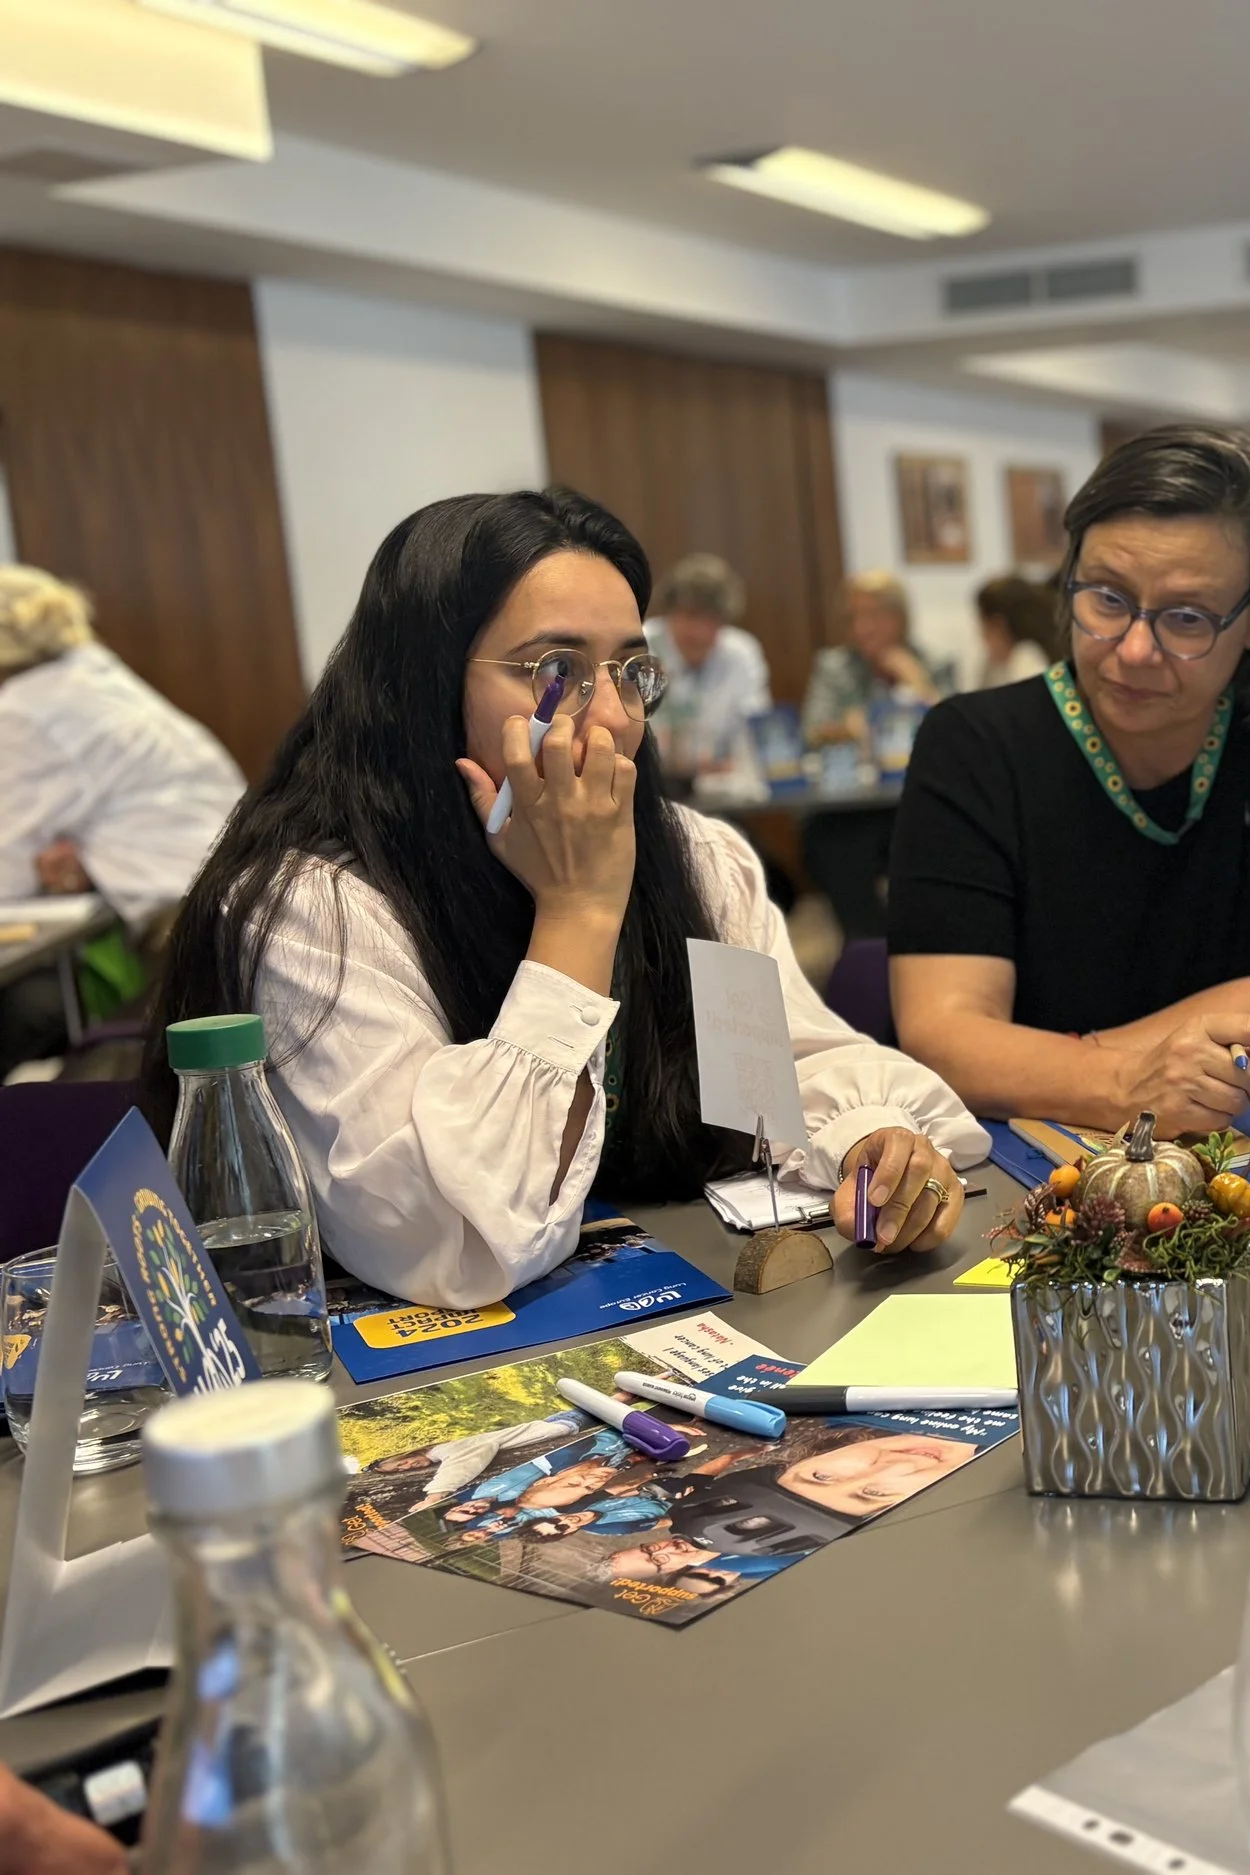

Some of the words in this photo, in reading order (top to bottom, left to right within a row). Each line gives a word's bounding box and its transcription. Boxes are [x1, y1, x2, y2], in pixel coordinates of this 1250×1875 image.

[633, 1286, 663, 1300] Cancer
[663, 1282, 687, 1291] Lung
[600, 1297, 632, 1310] Europe
[387, 1307, 455, 1326] PORT
[398, 1314, 484, 1339] 2024
[697, 1323, 730, 1345] Natasha
[674, 1334, 700, 1351] cancer
[669, 1349, 702, 1369] language
[699, 1349, 715, 1363] lung
[736, 1376, 757, 1387] the
[728, 1385, 756, 1394] give
[891, 1412, 919, 1425] lung
[920, 1418, 960, 1430] online
[959, 1414, 982, 1424] the
[985, 1420, 1006, 1428] me
[609, 1576, 700, 1602] supported!
[613, 1588, 651, 1607] Get
